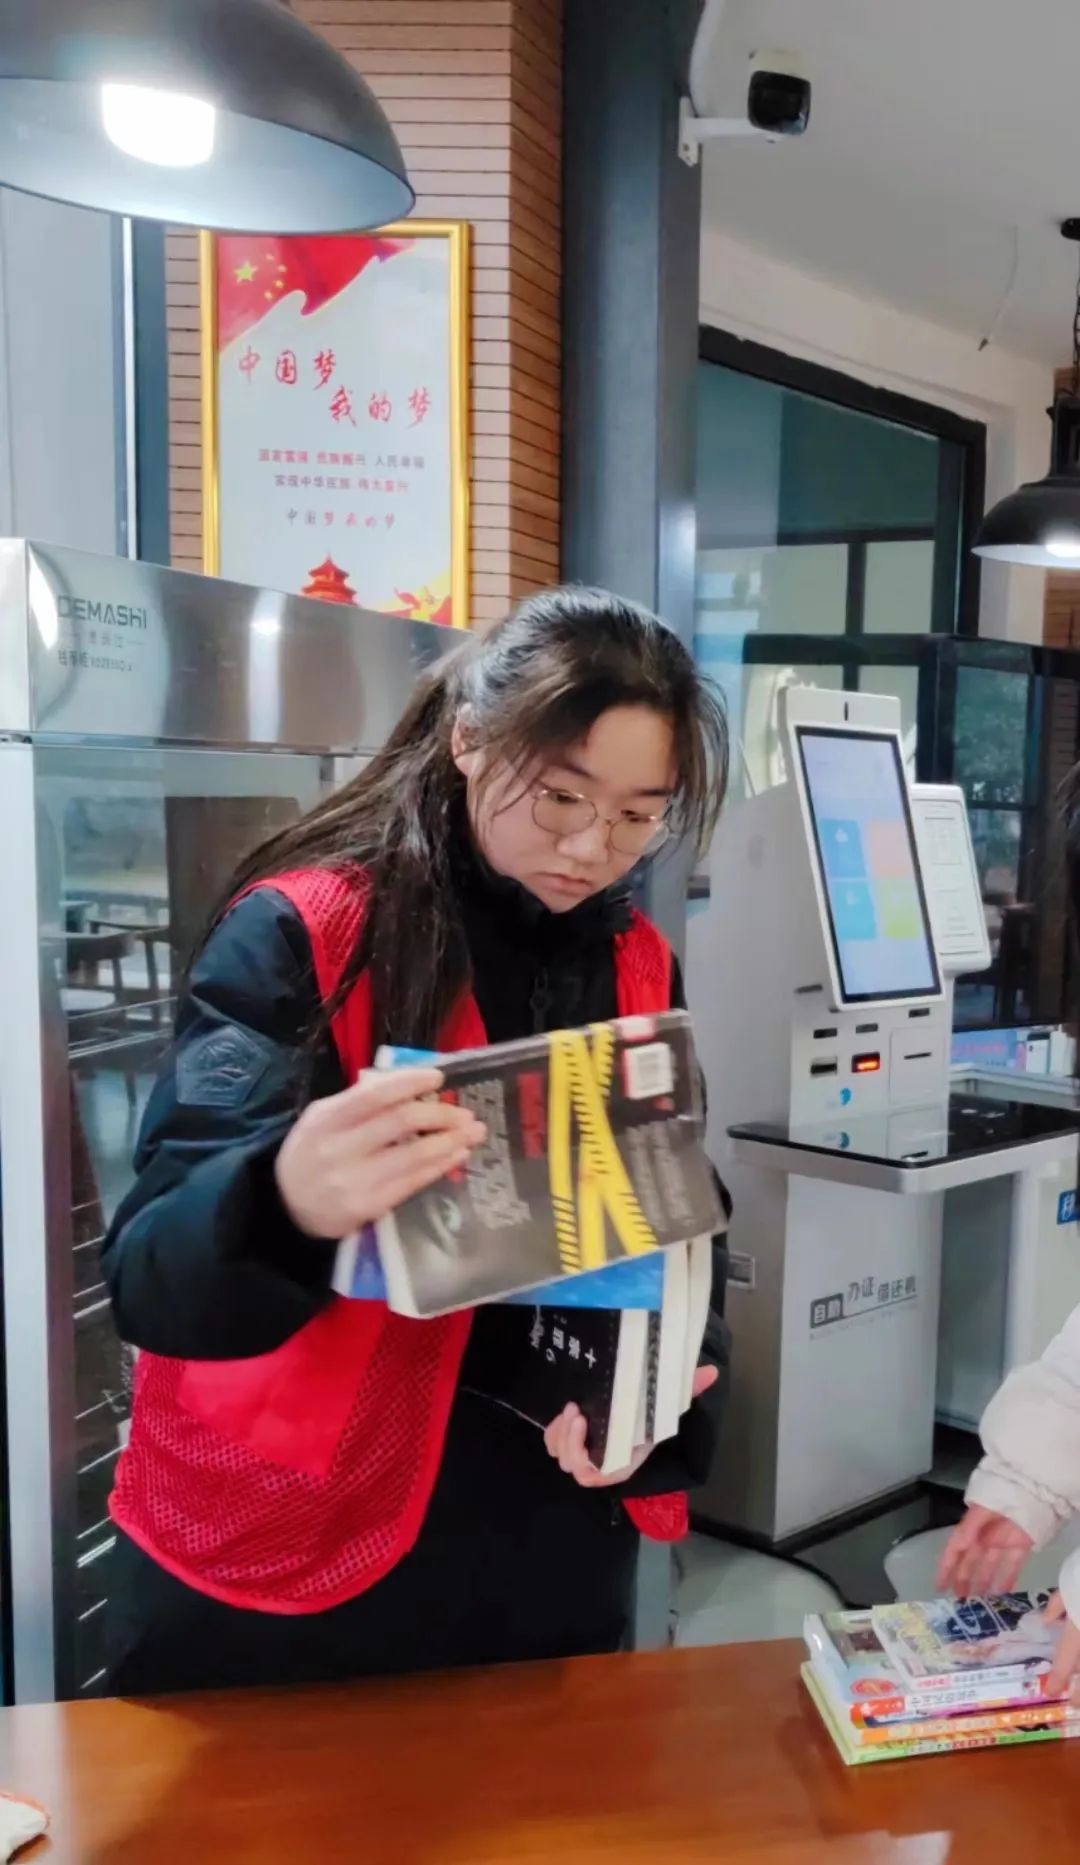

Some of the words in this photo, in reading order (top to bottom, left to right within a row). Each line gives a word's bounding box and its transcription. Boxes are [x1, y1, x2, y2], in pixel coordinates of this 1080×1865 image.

[239, 345, 336, 390] 中国梦
[329, 385, 431, 430] 我的梦
[58, 595, 147, 629] DEMASHI
